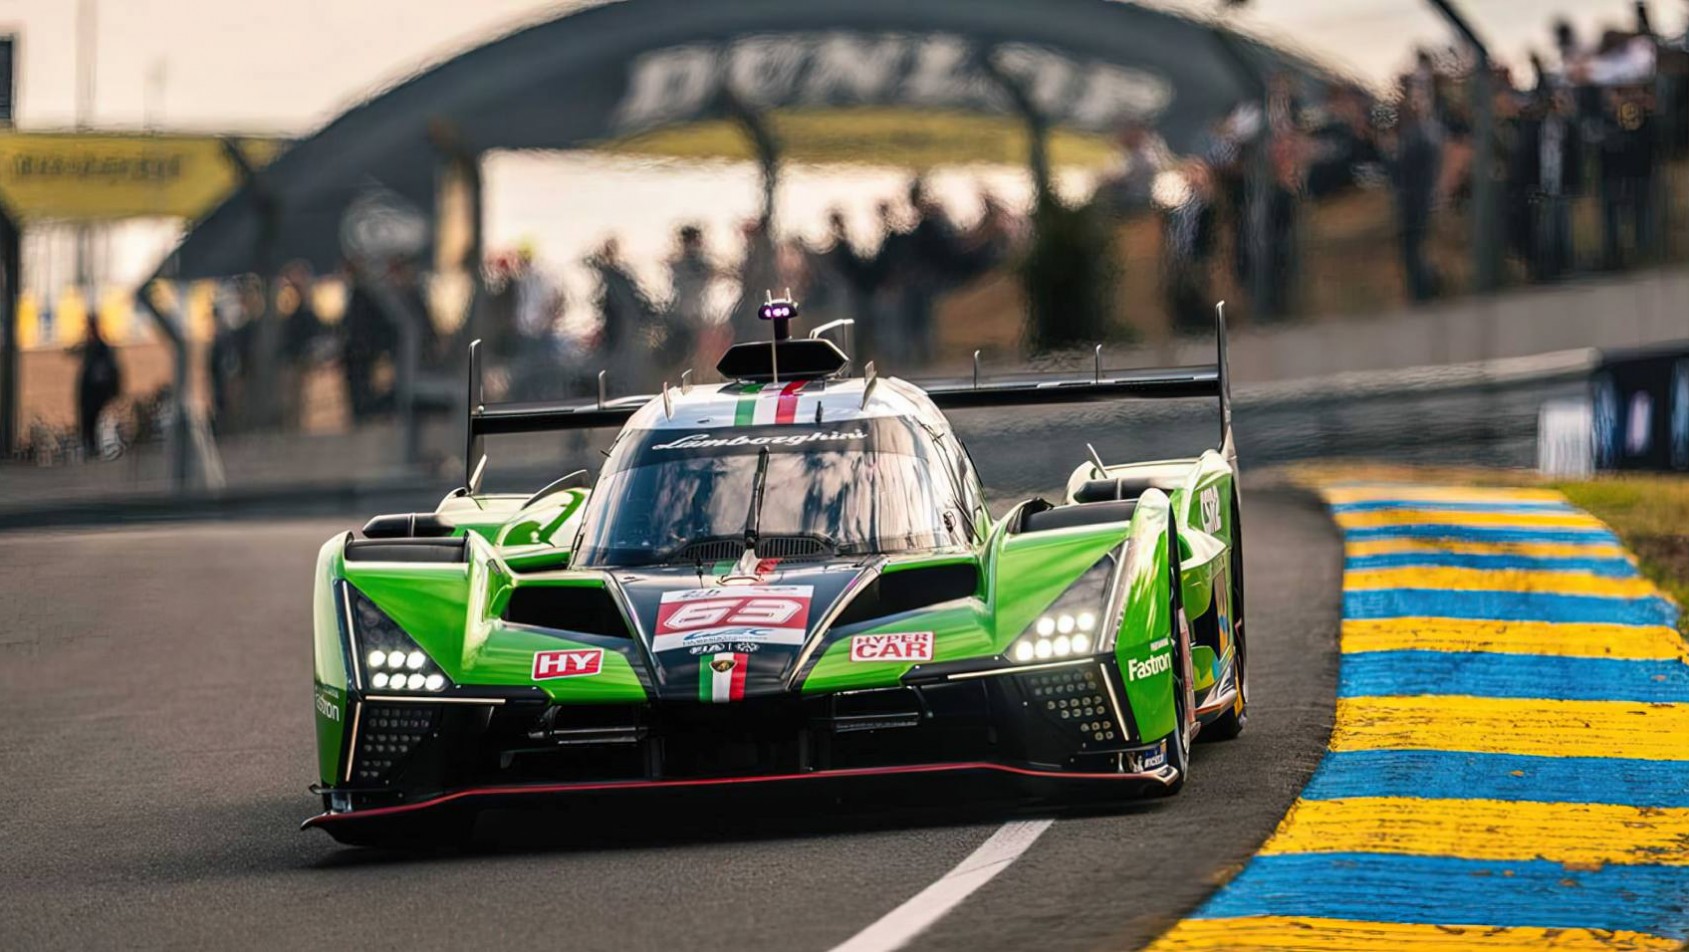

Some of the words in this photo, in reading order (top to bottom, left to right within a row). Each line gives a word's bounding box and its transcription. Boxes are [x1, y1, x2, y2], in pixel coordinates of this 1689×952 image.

[652, 428, 867, 450] Lamborghini
[663, 599, 803, 629] 63
[857, 633, 928, 644] HYPER
[856, 642, 927, 658] CAR
[539, 652, 598, 674] HY
[1128, 652, 1171, 682] Fastron
